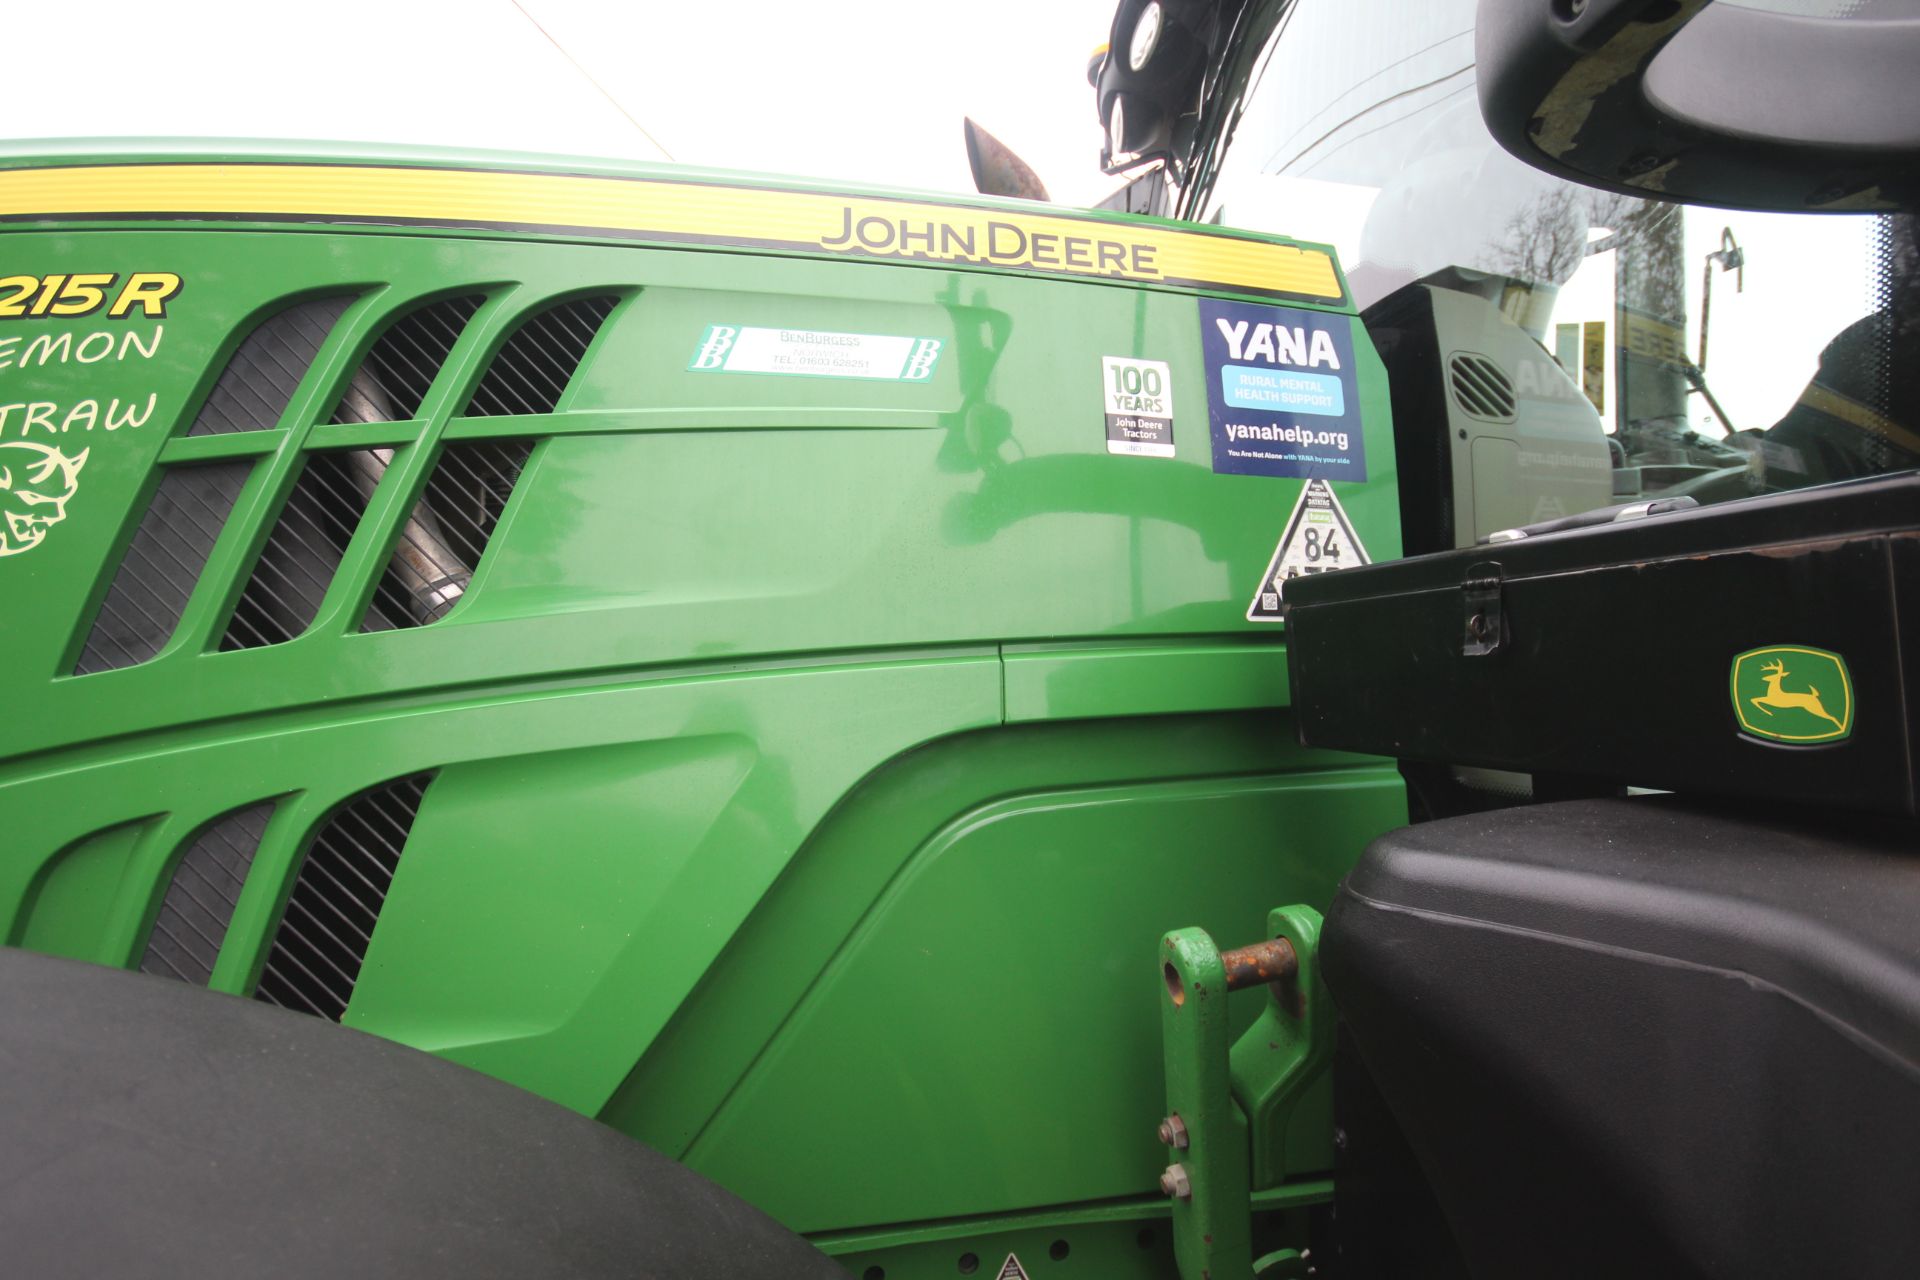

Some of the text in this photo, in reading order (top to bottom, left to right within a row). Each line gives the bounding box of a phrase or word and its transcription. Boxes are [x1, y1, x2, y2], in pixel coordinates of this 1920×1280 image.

[821, 207, 1159, 274] JOHN DEERE
[1216, 318, 1340, 370] YANA
[1110, 364, 1162, 397] 100
[1239, 374, 1324, 393] RURAL MENTAL
[1113, 394, 1163, 413] YEARS
[1234, 387, 1333, 408] HEALTH SUPPORT
[1116, 417, 1163, 430] John Deere
[1123, 427, 1158, 440] Tractors
[1225, 423, 1349, 450] yanahelp.org
[1227, 449, 1240, 457] You
[1241, 450, 1252, 458] Are
[1252, 451, 1264, 459] Not
[1265, 452, 1282, 460] Alone
[1283, 453, 1297, 461] with
[1314, 455, 1323, 463] by
[1338, 457, 1350, 465] side
[1304, 527, 1341, 562] 84
